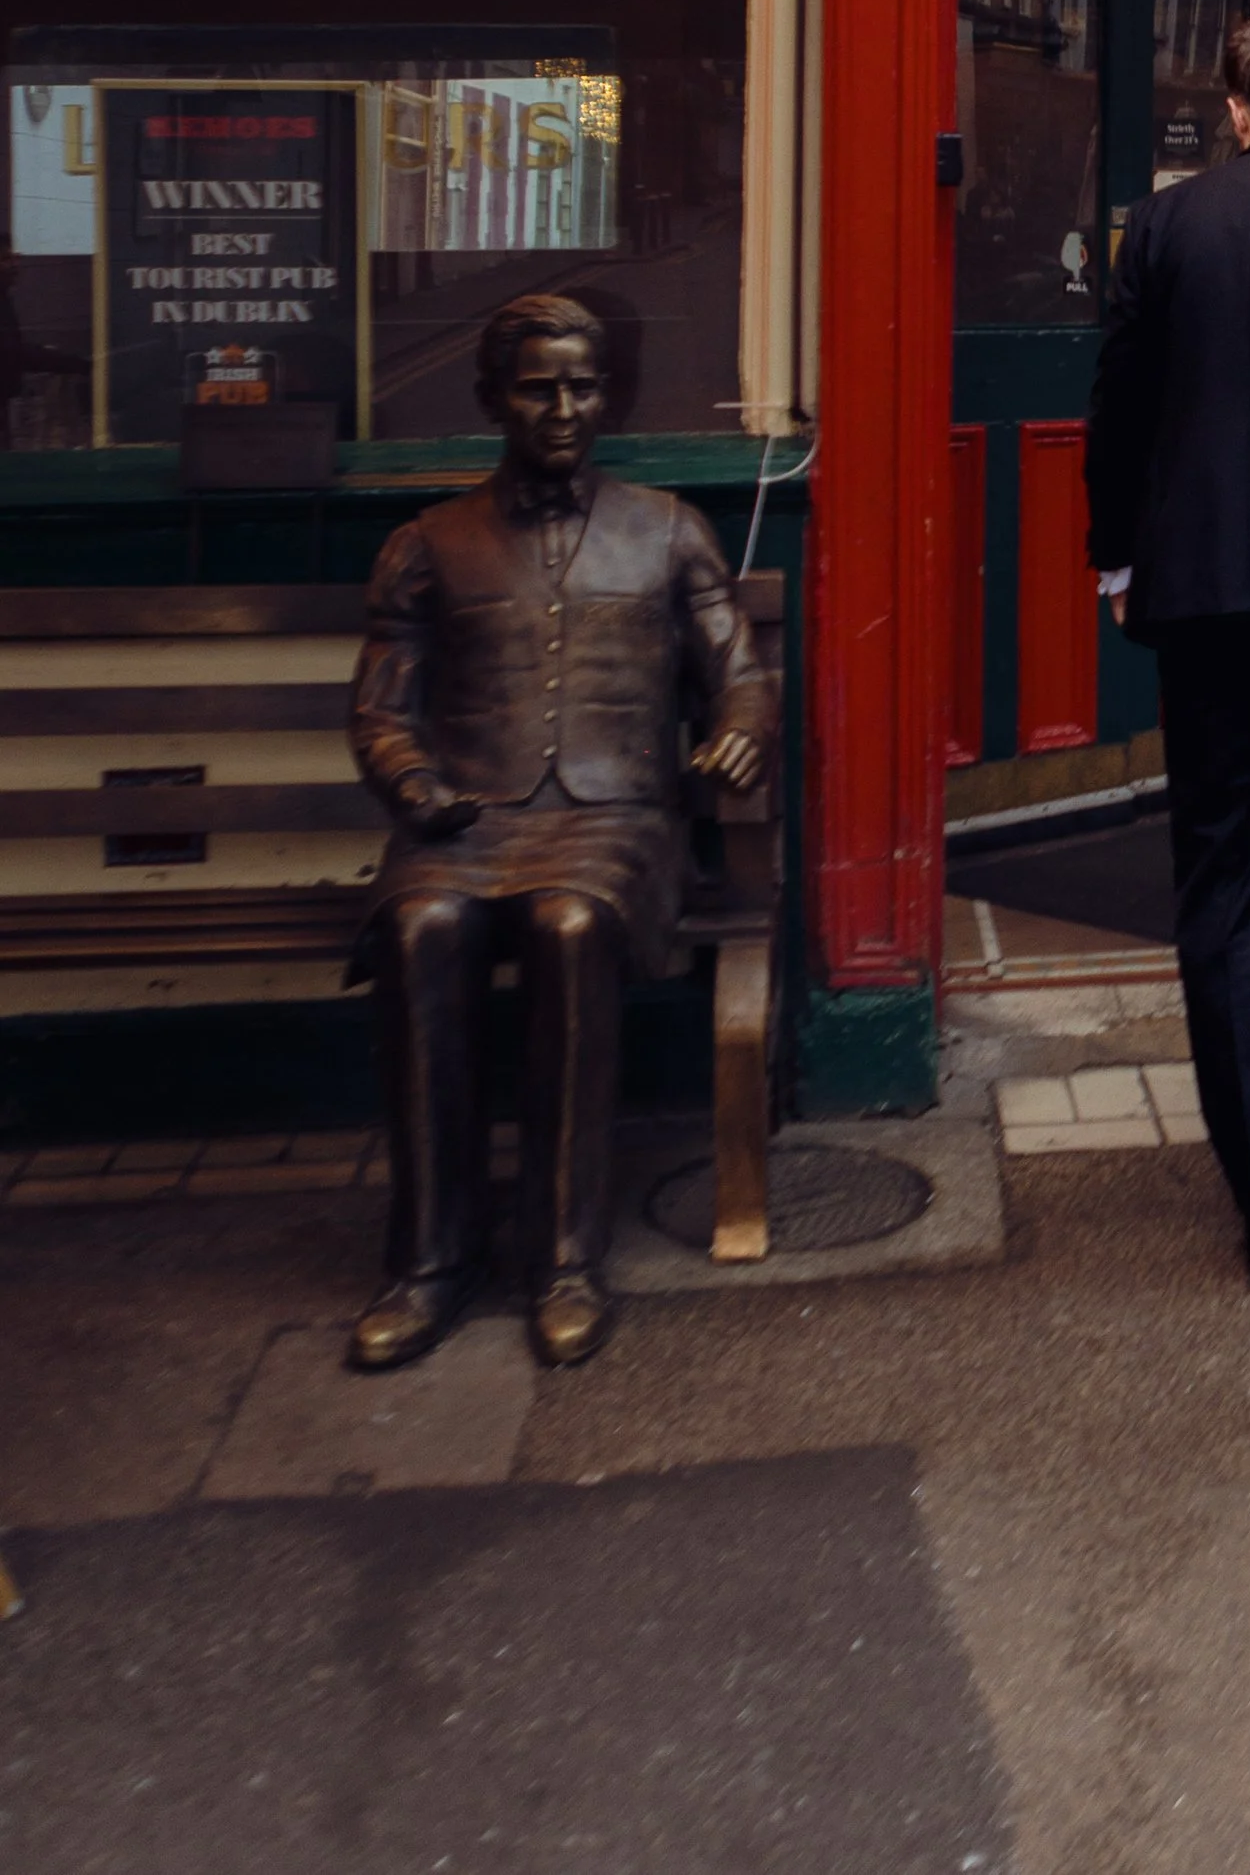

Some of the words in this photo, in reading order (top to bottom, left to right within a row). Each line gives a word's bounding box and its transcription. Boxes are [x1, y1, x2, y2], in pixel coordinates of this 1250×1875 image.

[142, 180, 324, 210] WINNER
[190, 233, 275, 255] BEST
[125, 266, 266, 290] TOURIST
[268, 266, 340, 290] PUB
[1065, 281, 1089, 293] PULL
[151, 300, 188, 324] IN
[189, 300, 316, 324] DUBLIN
[195, 382, 269, 406] PUB
